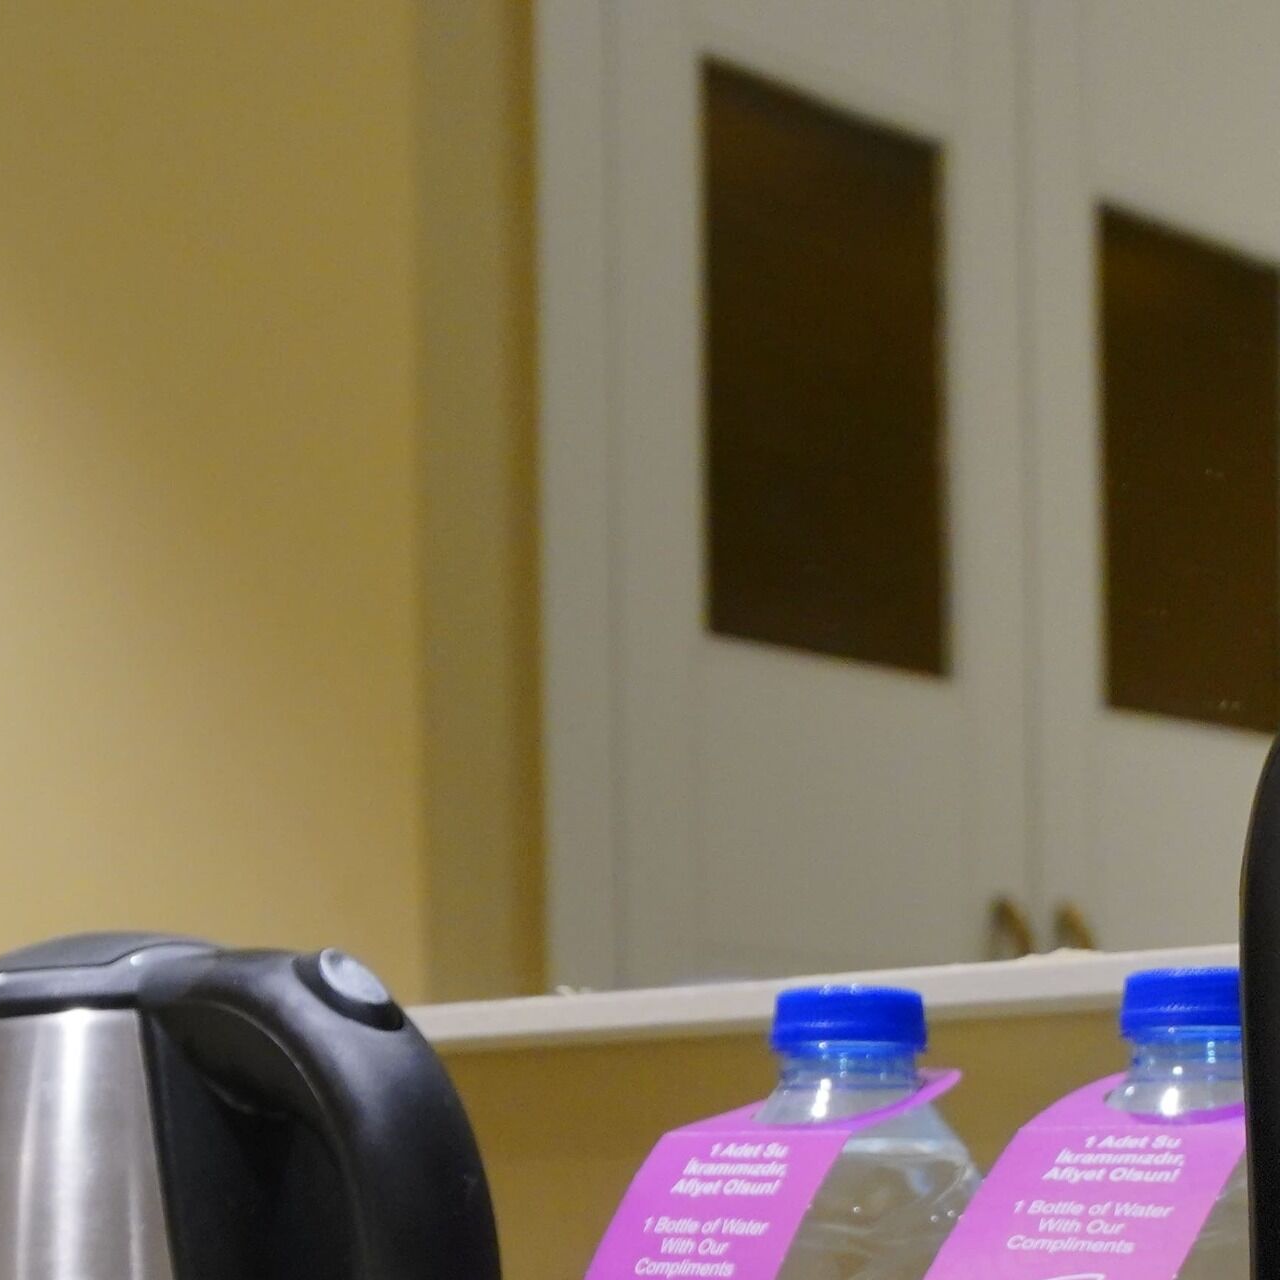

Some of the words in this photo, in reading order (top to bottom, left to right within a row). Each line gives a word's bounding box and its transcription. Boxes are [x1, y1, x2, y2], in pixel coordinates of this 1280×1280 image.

[710, 1142, 722, 1158] 1
[719, 1143, 762, 1158] Adet
[763, 1142, 790, 1158] Su
[1084, 1135, 1097, 1149] 1
[1097, 1135, 1150, 1150] Adet
[1151, 1134, 1182, 1150] Su
[1041, 1166, 1107, 1184] Afiyet
[1108, 1167, 1182, 1182] Olsun!
[670, 1178, 723, 1198] Afiyet
[723, 1178, 783, 1196] Olsun!
[1014, 1200, 1025, 1215] 1
[1027, 1199, 1085, 1216] Bottle
[1088, 1201, 1114, 1216] of
[1114, 1202, 1175, 1218] Water
[643, 1216, 654, 1233] 1
[654, 1216, 701, 1234] Bottle
[701, 1217, 721, 1234] of
[721, 1218, 770, 1236] Water
[1038, 1217, 1082, 1234] With
[1086, 1219, 1127, 1235] Our
[660, 1237, 697, 1255] With
[697, 1238, 731, 1256] Our
[1006, 1235, 1137, 1254] Compliments
[634, 1257, 736, 1279] Compliments
